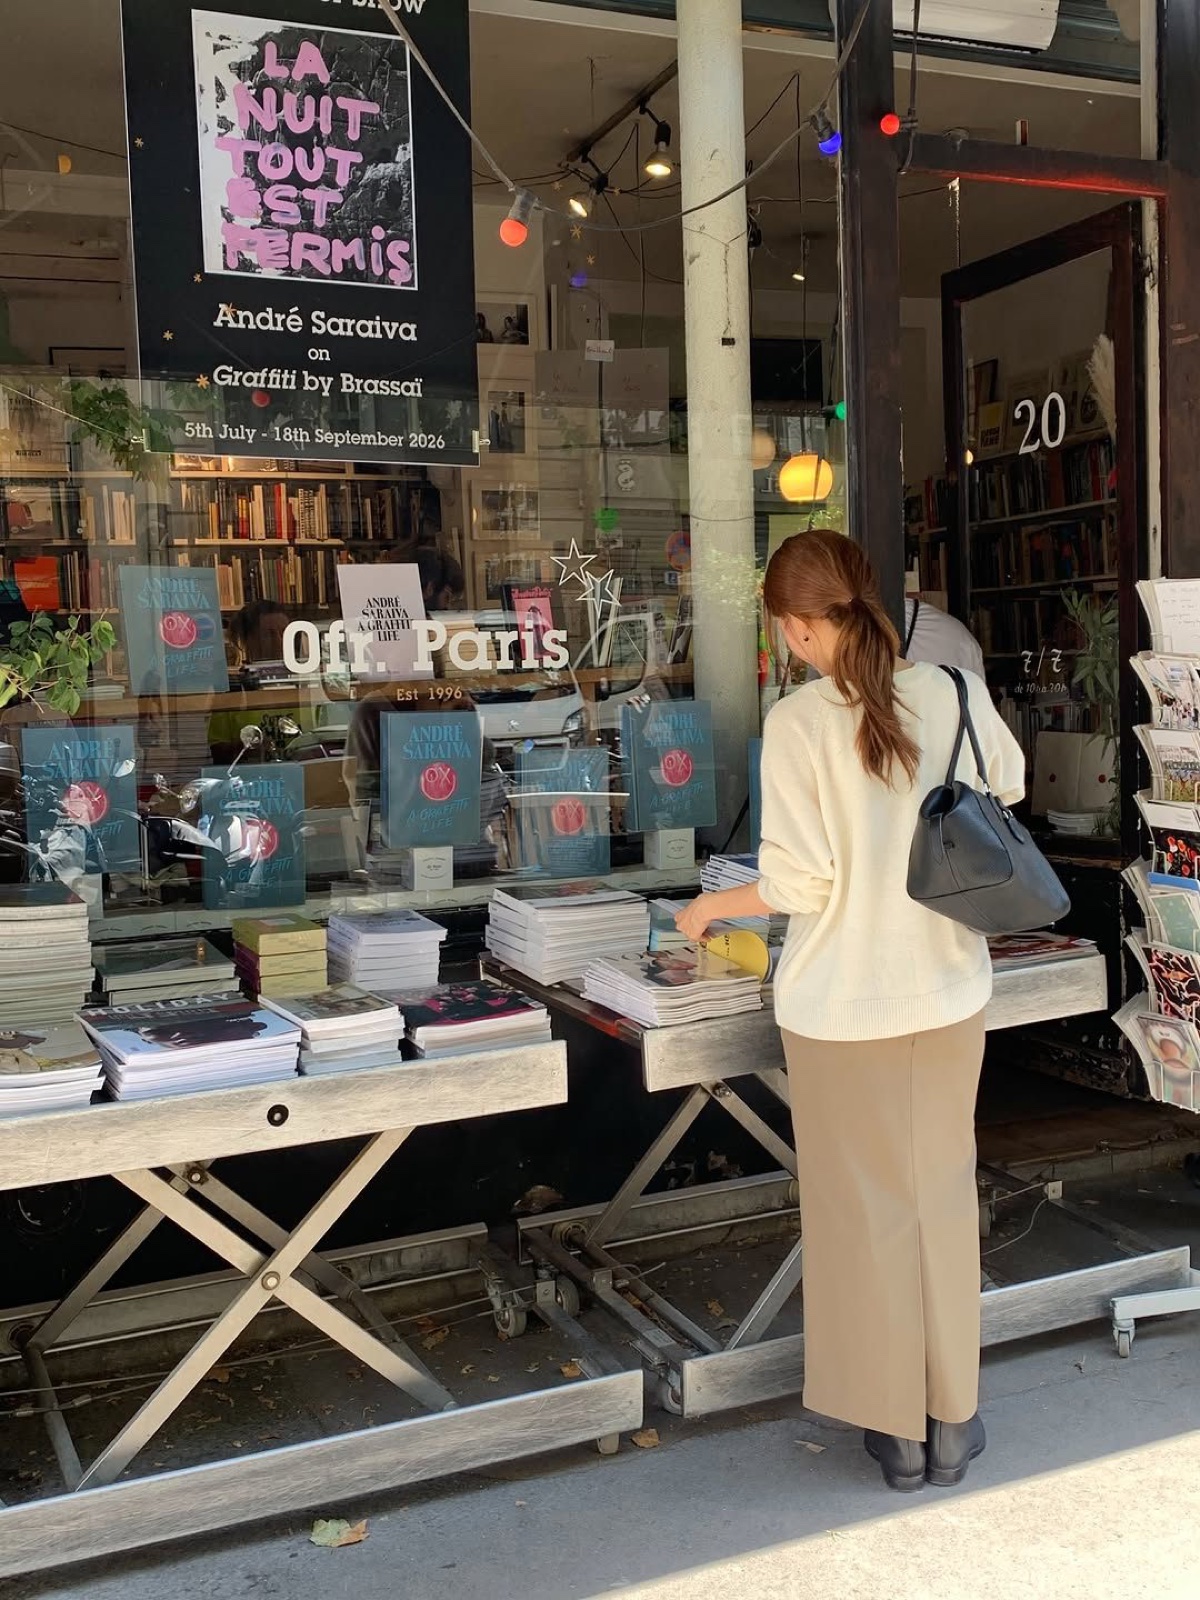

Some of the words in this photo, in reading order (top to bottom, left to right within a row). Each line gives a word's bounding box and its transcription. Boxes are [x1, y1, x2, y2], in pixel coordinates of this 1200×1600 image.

[264, 40, 331, 84] LA
[232, 82, 381, 141] NUIT
[214, 136, 364, 187] TOUT
[213, 303, 303, 333] André
[310, 310, 418, 342] Saraiva
[307, 347, 331, 361] on
[212, 364, 297, 390] Graffiti
[302, 370, 334, 396] by
[340, 373, 423, 398] Brassaï
[184, 423, 213, 438] 5th
[218, 424, 257, 443] July
[273, 427, 310, 442] 18th
[314, 429, 404, 448] September
[409, 433, 446, 449] 2026
[1013, 391, 1066, 455] 20
[361, 608, 409, 620] SARAIVA
[282, 620, 387, 674] Ofr.
[411, 619, 570, 673] Paris
[397, 687, 419, 701] Est
[428, 686, 463, 701] 1996
[408, 721, 463, 742] ANDRÉ
[401, 741, 472, 760] SARAIVA
[86, 992, 230, 1017] HOLIDAY
